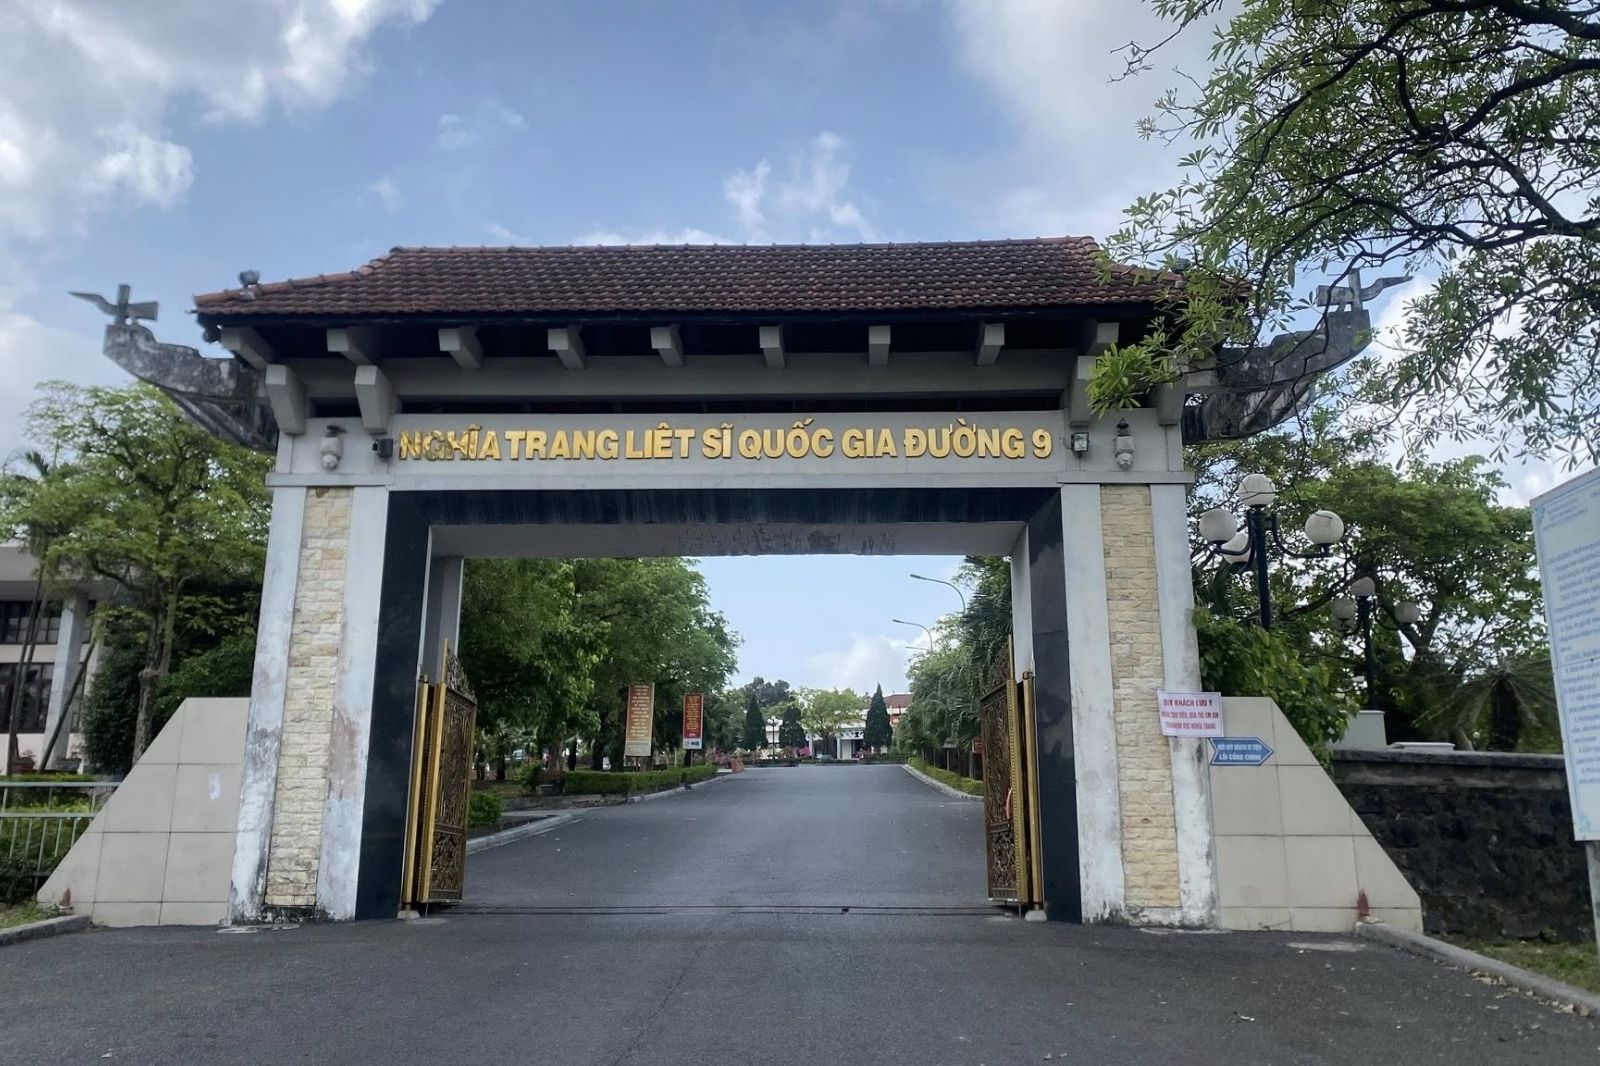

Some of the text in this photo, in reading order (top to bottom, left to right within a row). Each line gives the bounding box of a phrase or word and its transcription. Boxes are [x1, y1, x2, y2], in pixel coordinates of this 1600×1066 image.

[398, 424, 500, 460] NGHĨA
[504, 430, 619, 460] TRANG
[702, 423, 733, 459] SĨ
[738, 418, 834, 461] QUỐC
[841, 428, 898, 459] GIA
[903, 418, 1025, 459] ĐƯỜNG
[1032, 428, 1053, 459] 9
